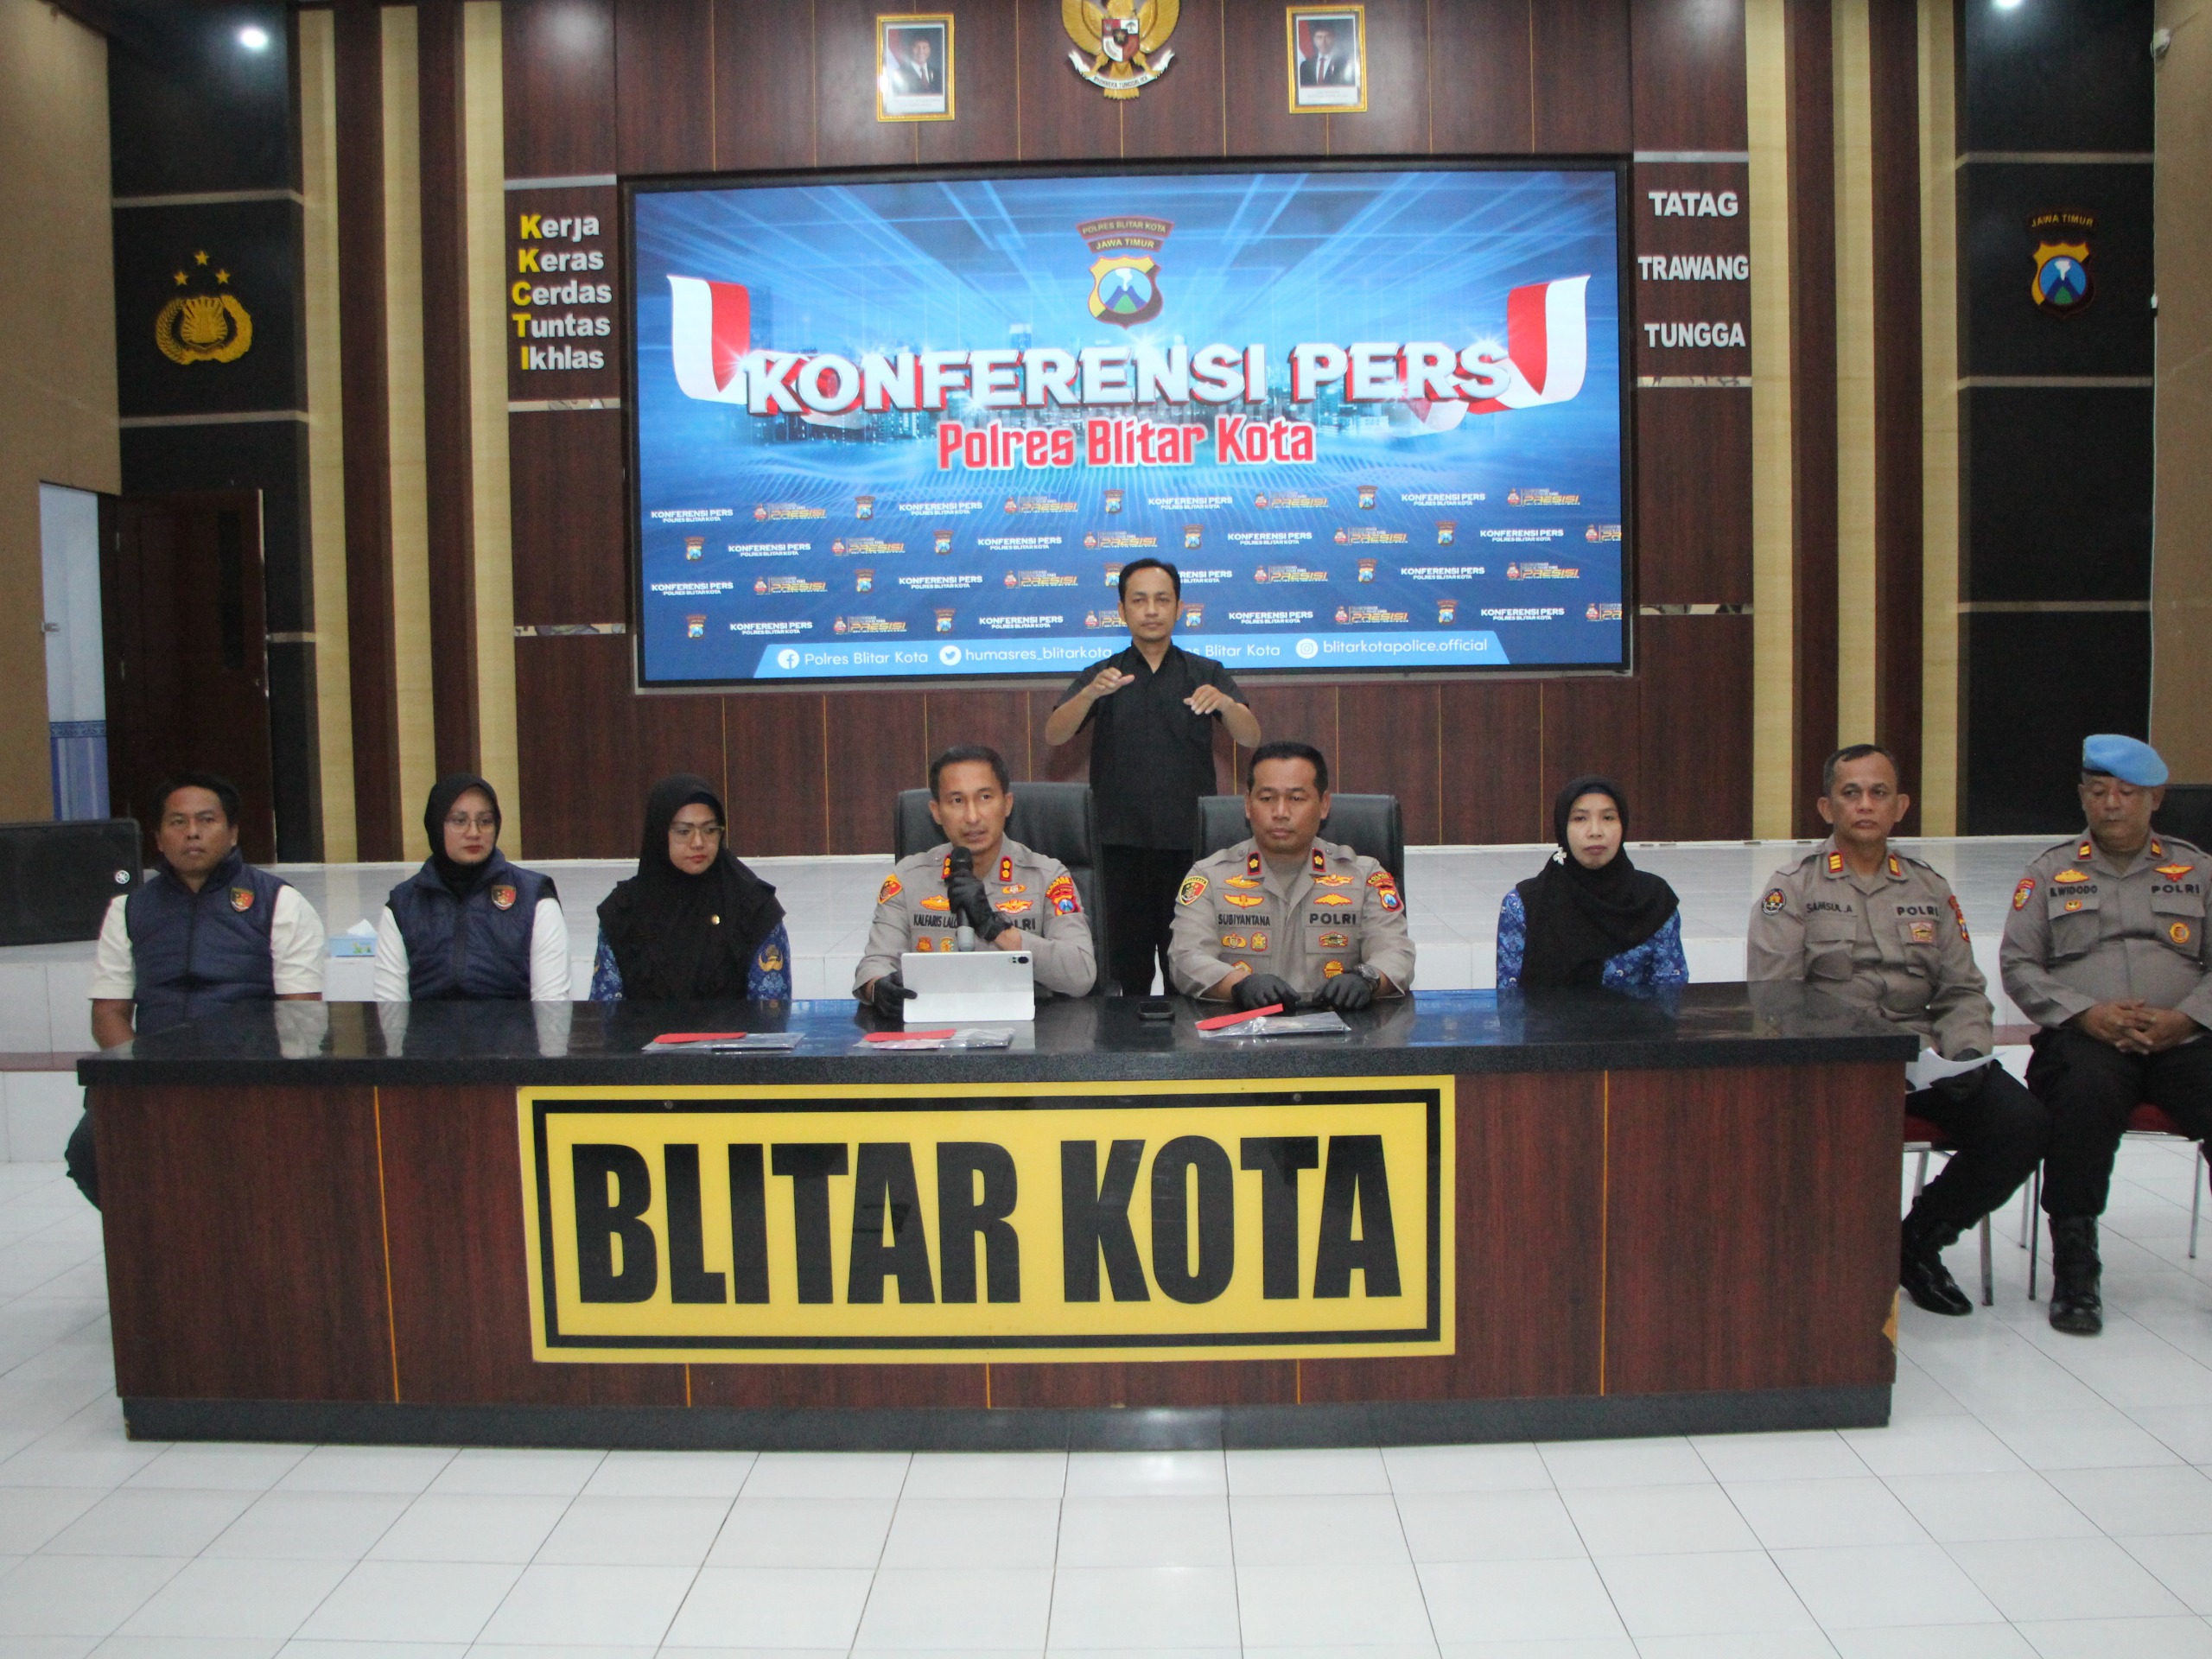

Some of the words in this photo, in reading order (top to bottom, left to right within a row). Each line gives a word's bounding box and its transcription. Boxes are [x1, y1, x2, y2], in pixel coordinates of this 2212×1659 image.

[1649, 192, 1738, 217] TATAG
[2031, 214, 2059, 227] JAWA
[2062, 214, 2094, 226] TIMUR
[520, 214, 600, 242] Kerja
[1082, 221, 1115, 234] POLRES
[1145, 222, 1166, 233] KOTA
[1096, 238, 1122, 250] JAWA
[1125, 238, 1154, 248] TIMUR
[518, 248, 605, 273] Keras
[1637, 256, 1749, 280] TRAWANG
[512, 280, 612, 306] Cerdas
[512, 313, 611, 338] Tuntas
[1643, 323, 1745, 347] TUNGGA
[521, 346, 605, 370] Ikhlas
[745, 343, 1267, 415] KONFERENSI
[1289, 341, 1512, 404] PERS
[938, 420, 1076, 470] Polres
[1086, 416, 1207, 466] Blitar
[1216, 413, 1316, 465] Kota
[899, 501, 957, 512] KONFERENSI
[958, 500, 982, 509] PERS
[1147, 496, 1207, 505] KONFERENSI
[651, 509, 709, 518] KONFERENSI
[709, 508, 733, 517] PERS
[728, 543, 785, 552] KONFERENSI
[786, 542, 810, 550] PERS
[977, 537, 1036, 545] KONFERENSI
[1037, 536, 1062, 544] PERS
[651, 582, 709, 591] KONFERENSI
[709, 581, 734, 589] PERS
[899, 575, 957, 584] KONFERENSI
[958, 575, 982, 583] PERS
[729, 621, 787, 631] KONFERENSI
[788, 620, 812, 629] PERS
[979, 615, 1038, 625] KONFERENSI
[1205, 645, 1242, 657] Blitar
[1247, 645, 1280, 656] Kota
[1323, 639, 1488, 655] blitarkotapolice.official
[804, 652, 849, 665] Polres
[854, 652, 890, 664] Blitar
[895, 651, 928, 664] Kota
[966, 646, 1113, 662] humasres_blitarkota
[2152, 885, 2200, 893] POLRI
[1897, 906, 1939, 916] POLRI
[1217, 912, 1270, 926] SUBIYANTANA
[1310, 912, 1357, 925] POLRI
[571, 1141, 1020, 1305] BLITAR
[1060, 1134, 1402, 1302] KOTA
